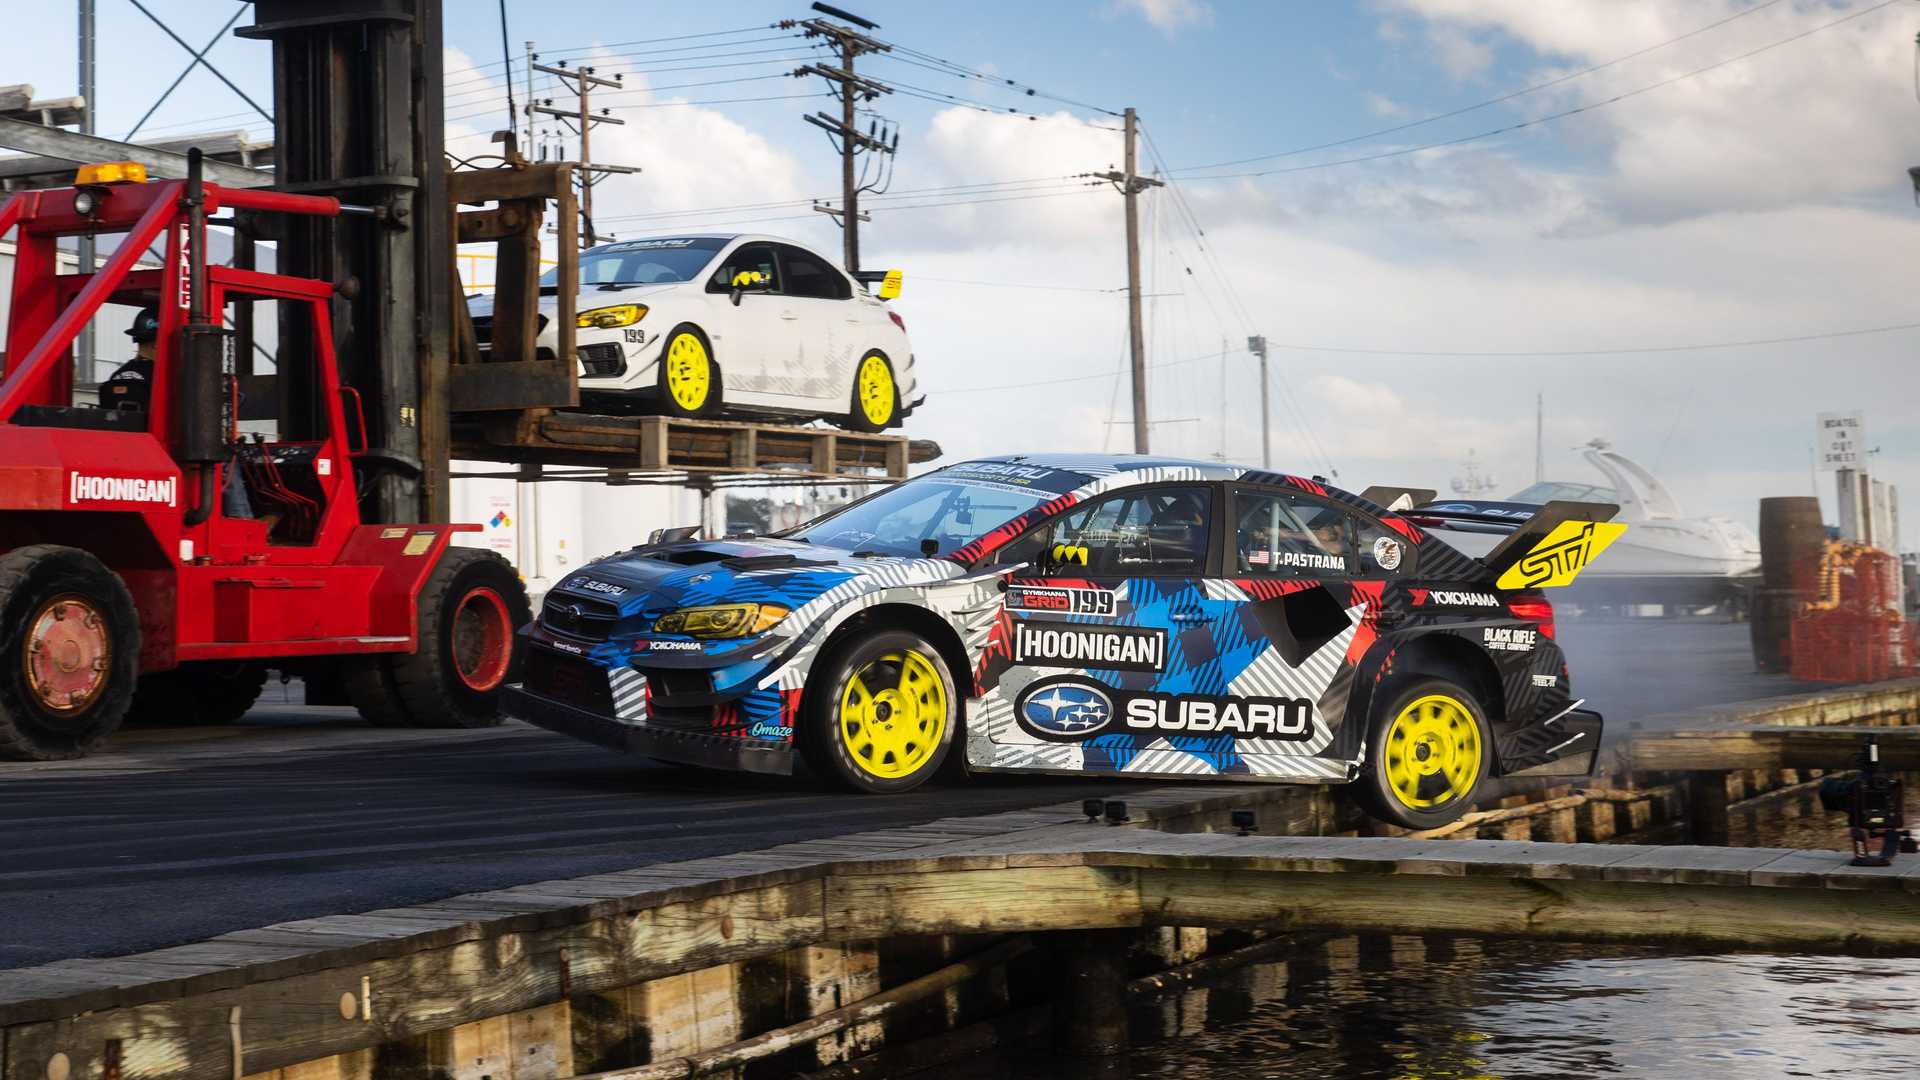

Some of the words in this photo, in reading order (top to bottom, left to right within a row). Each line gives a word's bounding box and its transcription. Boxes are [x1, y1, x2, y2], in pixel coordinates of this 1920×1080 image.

[623, 329, 645, 343] 199
[584, 580, 627, 596] SUBARU
[1023, 589, 1067, 597] GYMKHANA
[1023, 595, 1069, 609] GRID
[1071, 589, 1115, 614] 199
[1430, 591, 1500, 607] YOKOHAMA
[1483, 627, 1512, 643] BLACK
[1512, 629, 1537, 645] RIFLE
[649, 641, 701, 650] YOKOHAMA
[1488, 641, 1506, 649] COFFEE
[1507, 642, 1530, 652] COMPANY
[1126, 698, 1304, 734] SUBARU
[752, 721, 793, 737] Omaze
